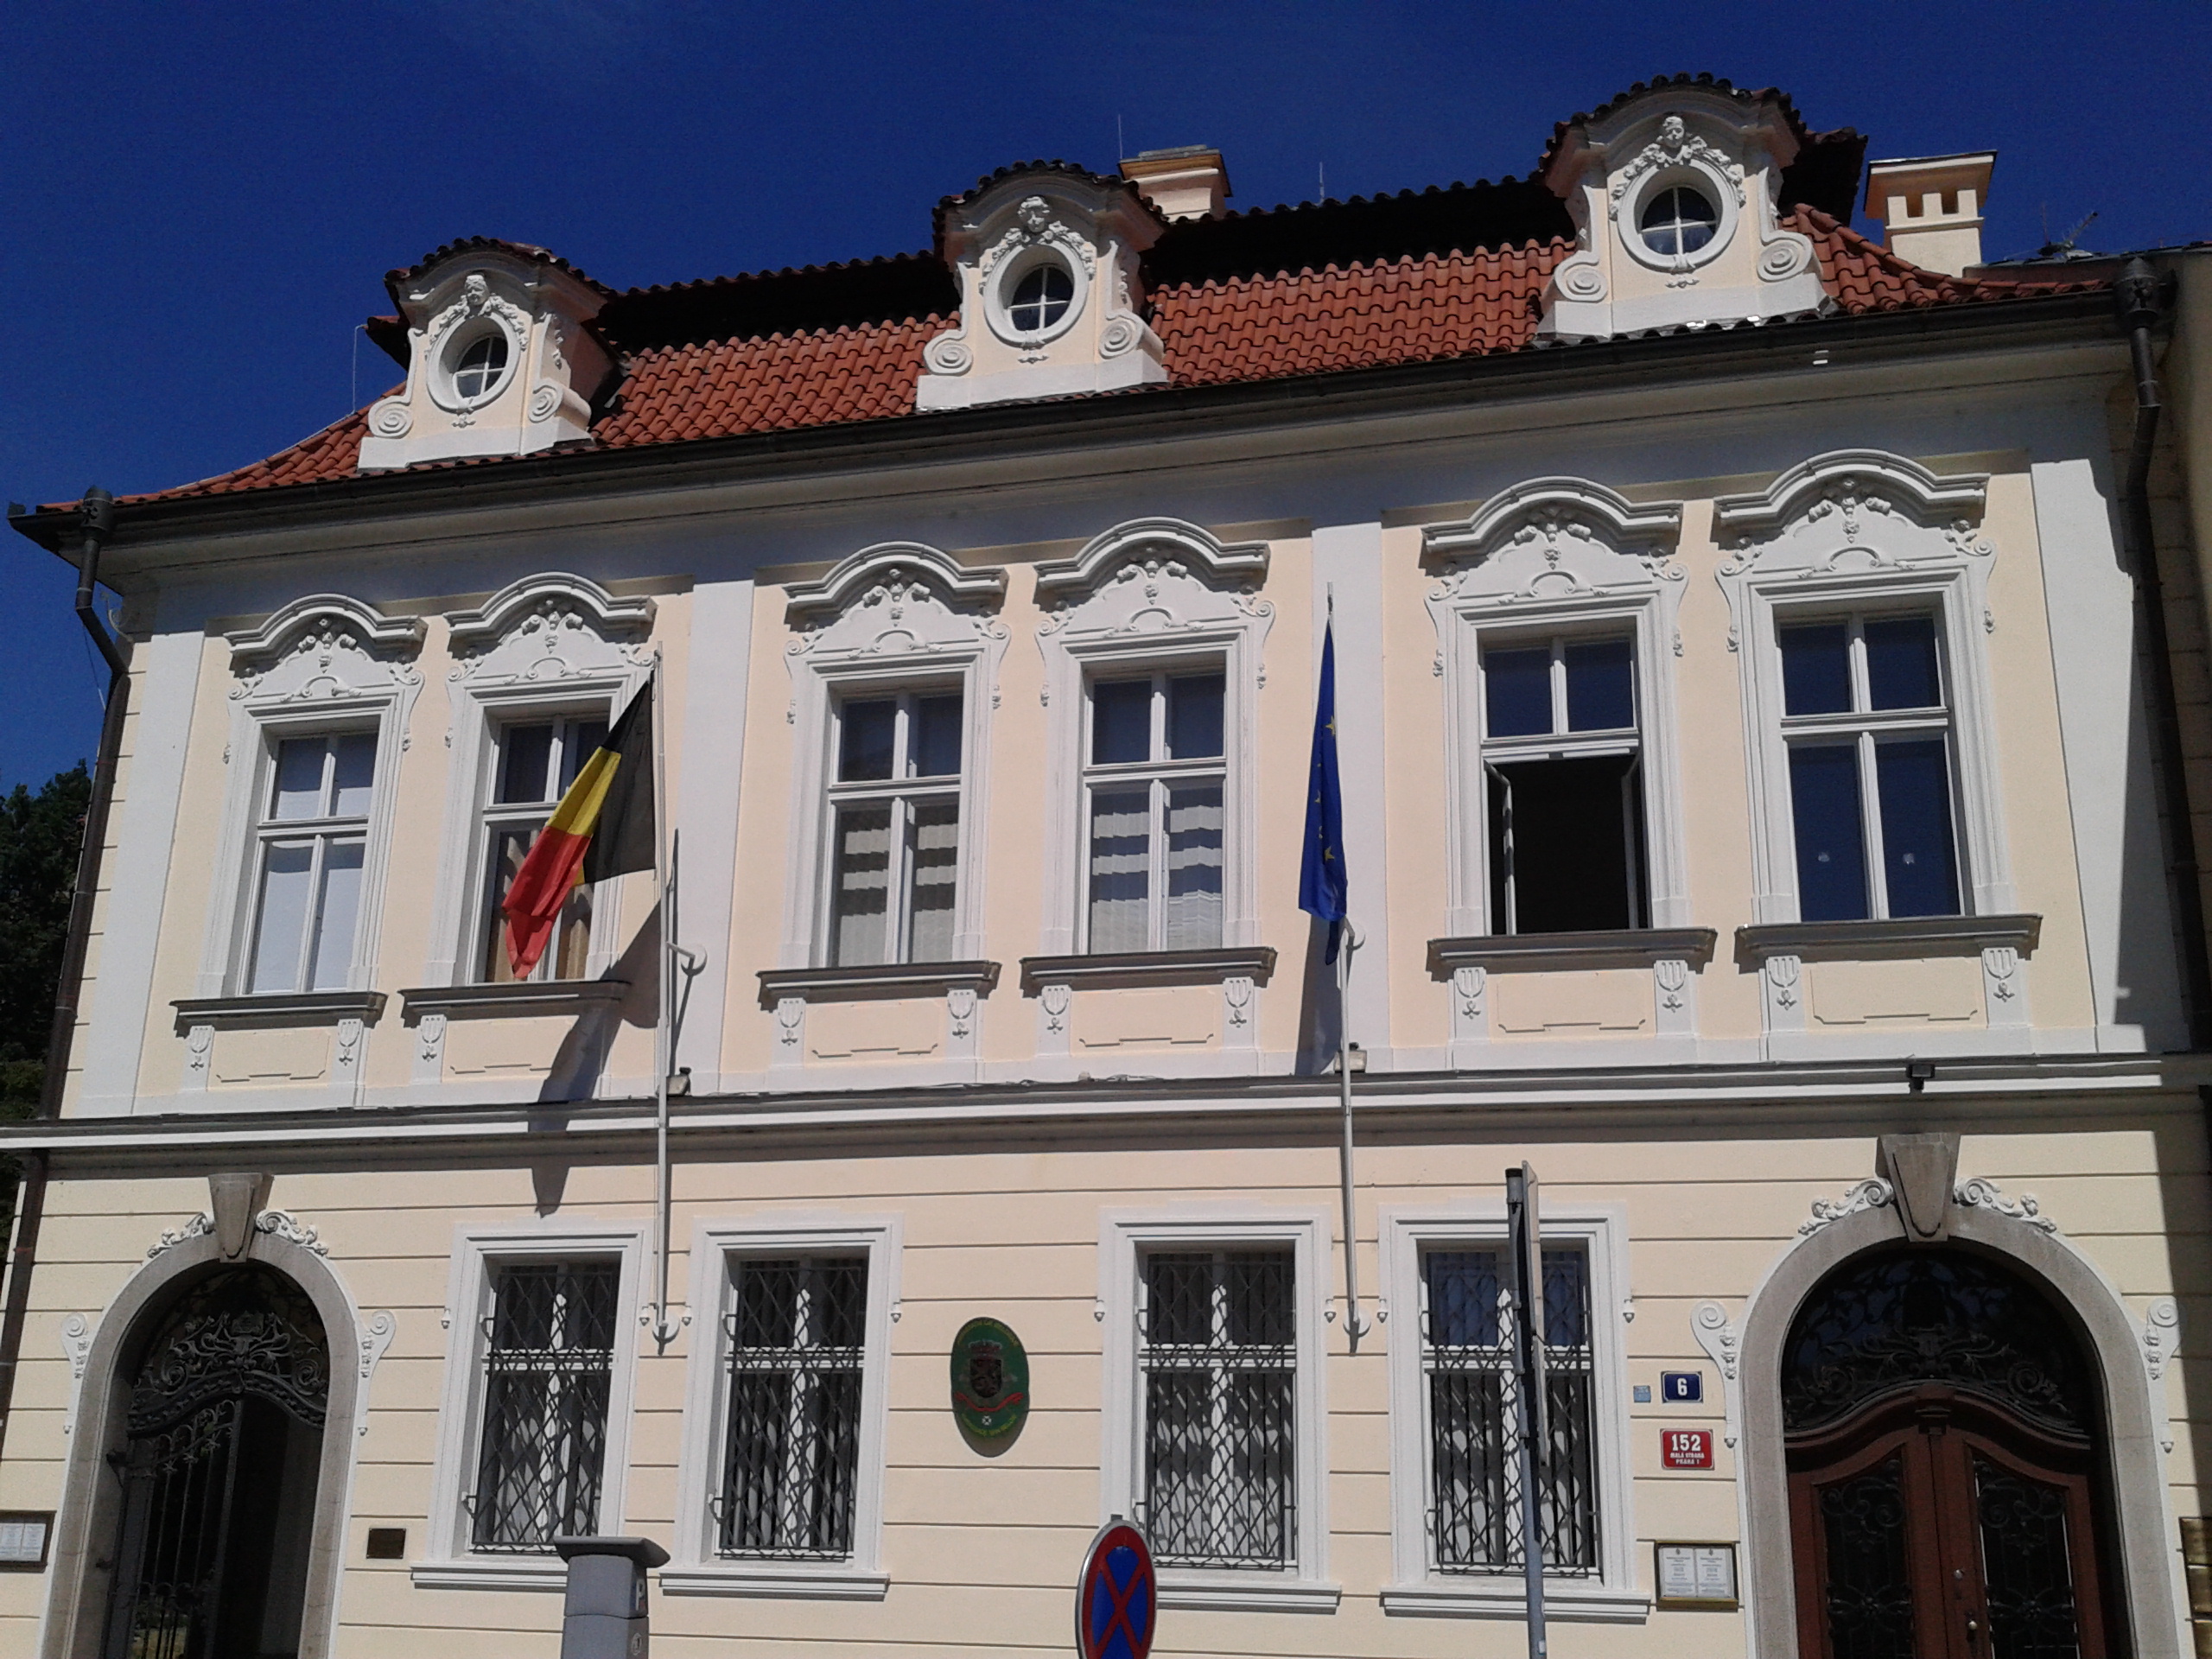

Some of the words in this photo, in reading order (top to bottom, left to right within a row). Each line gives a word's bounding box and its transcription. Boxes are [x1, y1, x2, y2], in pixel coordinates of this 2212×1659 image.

[1677, 1378, 1688, 1395] 6
[1671, 1434, 1701, 1452] 152
[635, 1578, 645, 1611] P
